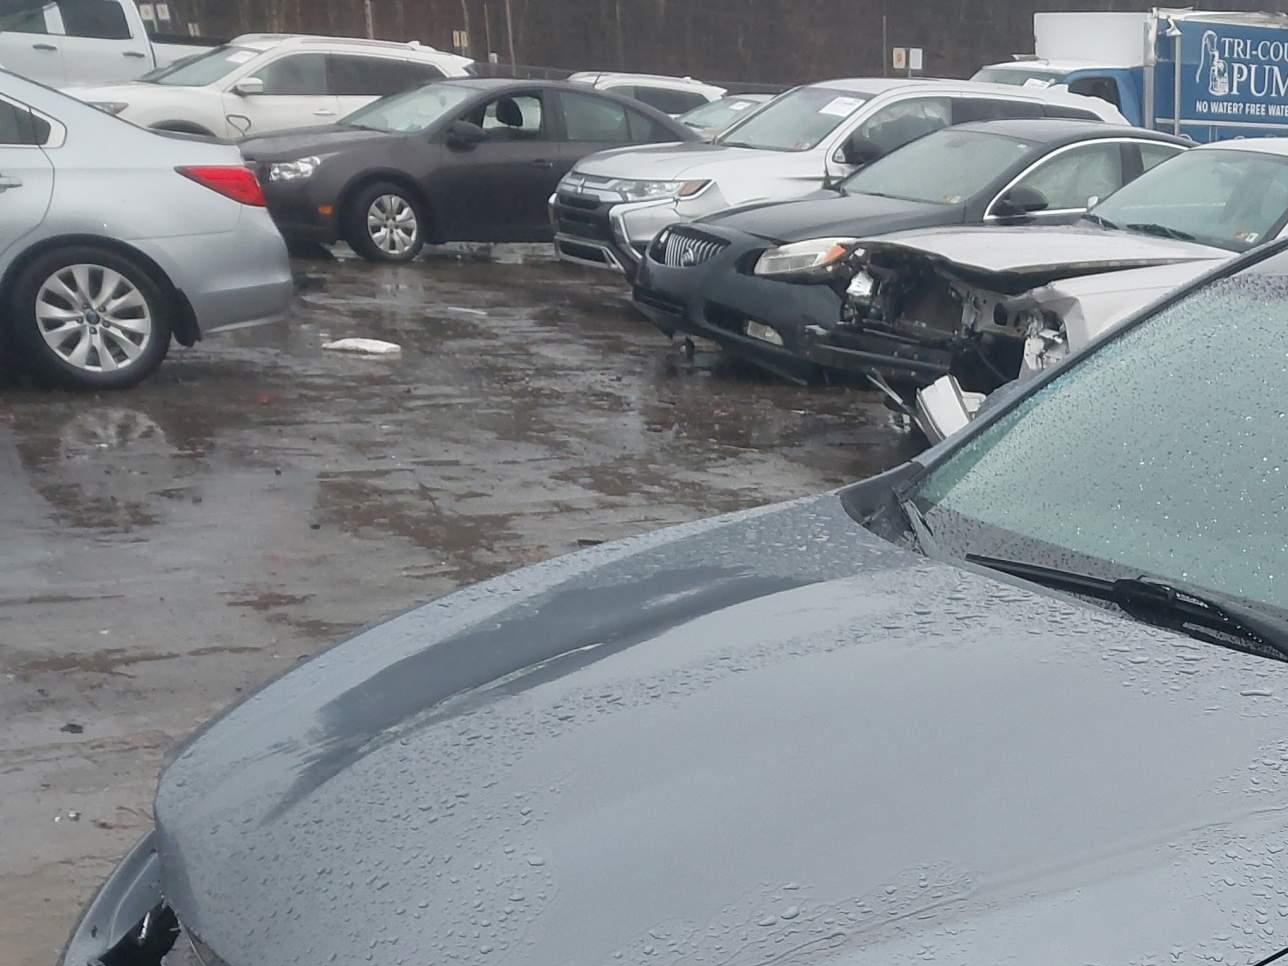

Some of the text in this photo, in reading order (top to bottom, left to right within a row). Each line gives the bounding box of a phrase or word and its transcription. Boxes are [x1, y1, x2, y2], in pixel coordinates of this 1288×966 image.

[1195, 100, 1209, 113] NO
[1210, 101, 1244, 114] WATER?
[1245, 103, 1266, 116] FREE
